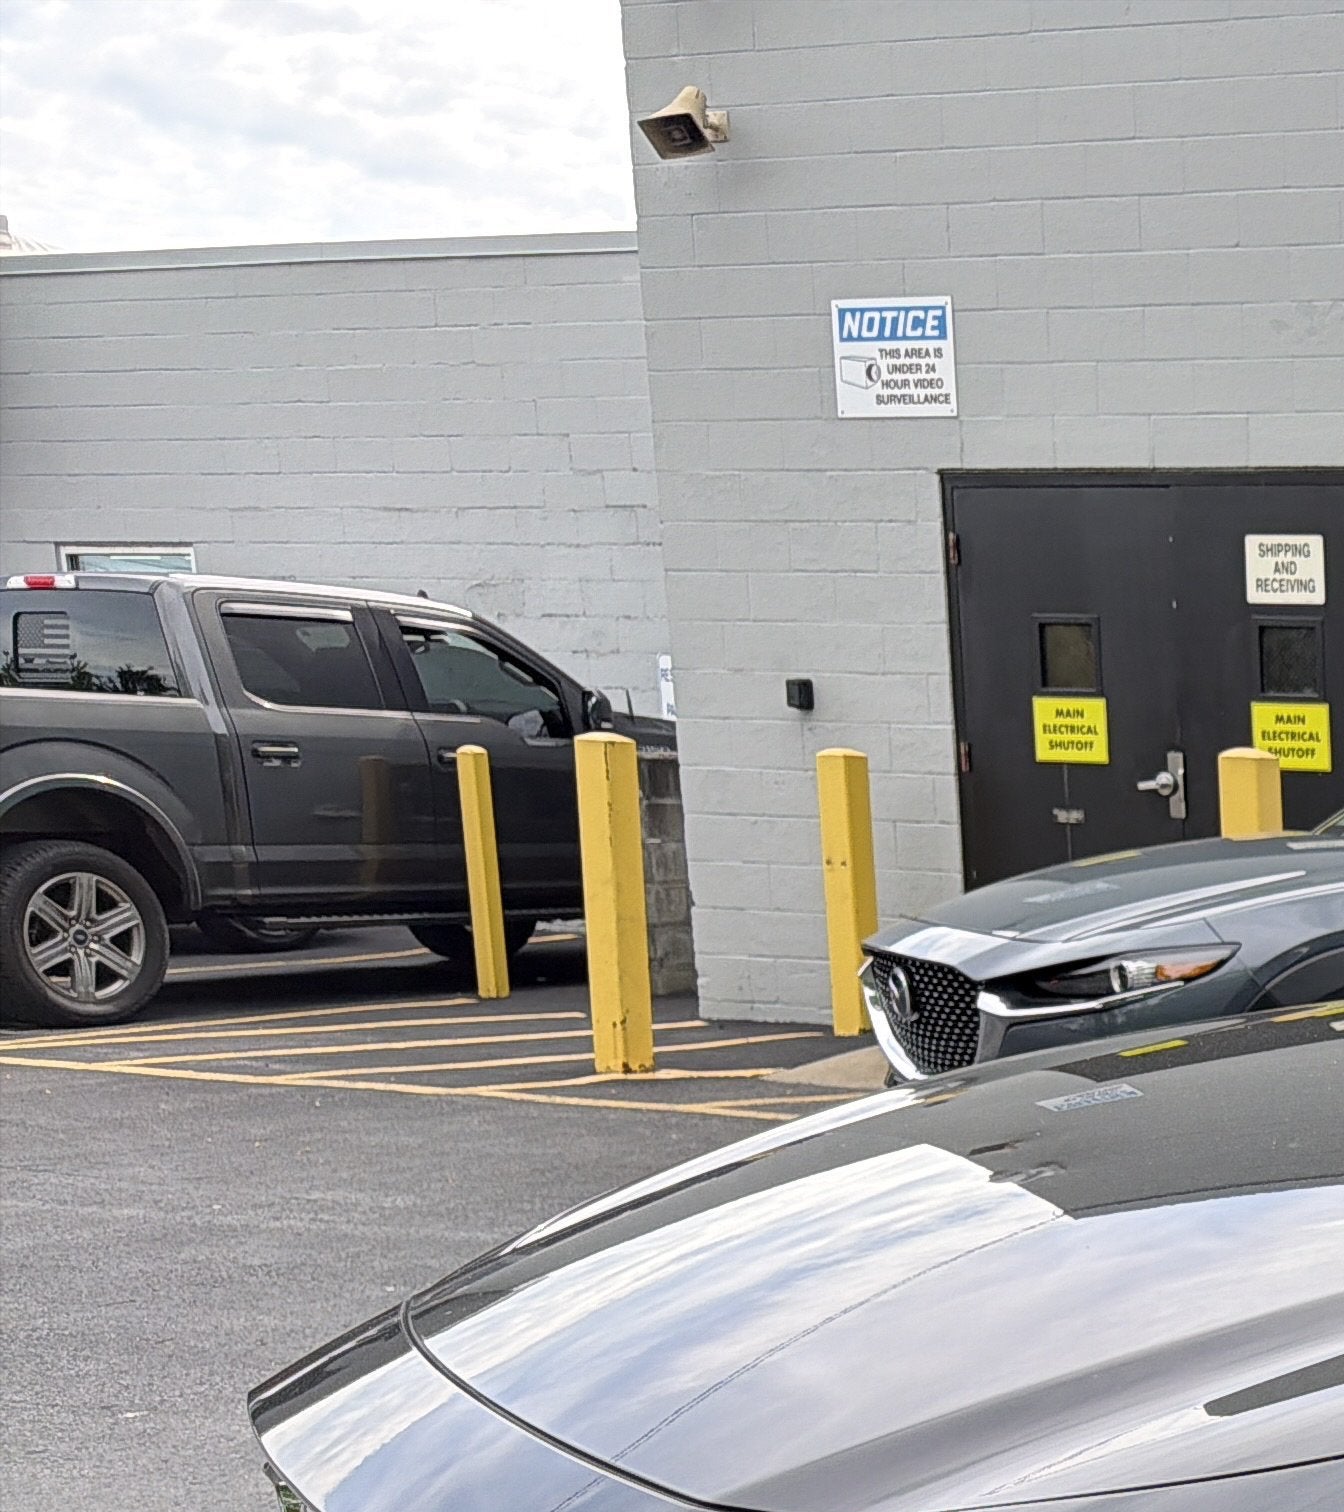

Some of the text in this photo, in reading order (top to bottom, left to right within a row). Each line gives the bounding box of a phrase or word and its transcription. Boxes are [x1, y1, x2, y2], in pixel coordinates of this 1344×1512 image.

[842, 309, 943, 338] NOTICE
[878, 347, 944, 360] THIS AREA IS
[887, 363, 937, 375] UNDER 24
[881, 377, 944, 390] HOUR VIDEO
[876, 393, 951, 405] SURVEILLANCE
[1258, 543, 1311, 558] SHIPPING
[1273, 560, 1298, 575] AND
[1255, 578, 1316, 593] RECEIVING
[1055, 708, 1084, 719] MAIN
[1275, 714, 1305, 725] MAIN
[1042, 724, 1099, 736] ELECTRICAL
[1261, 730, 1321, 742] ELECTRICAL
[1048, 740, 1094, 752] SHUTOFF
